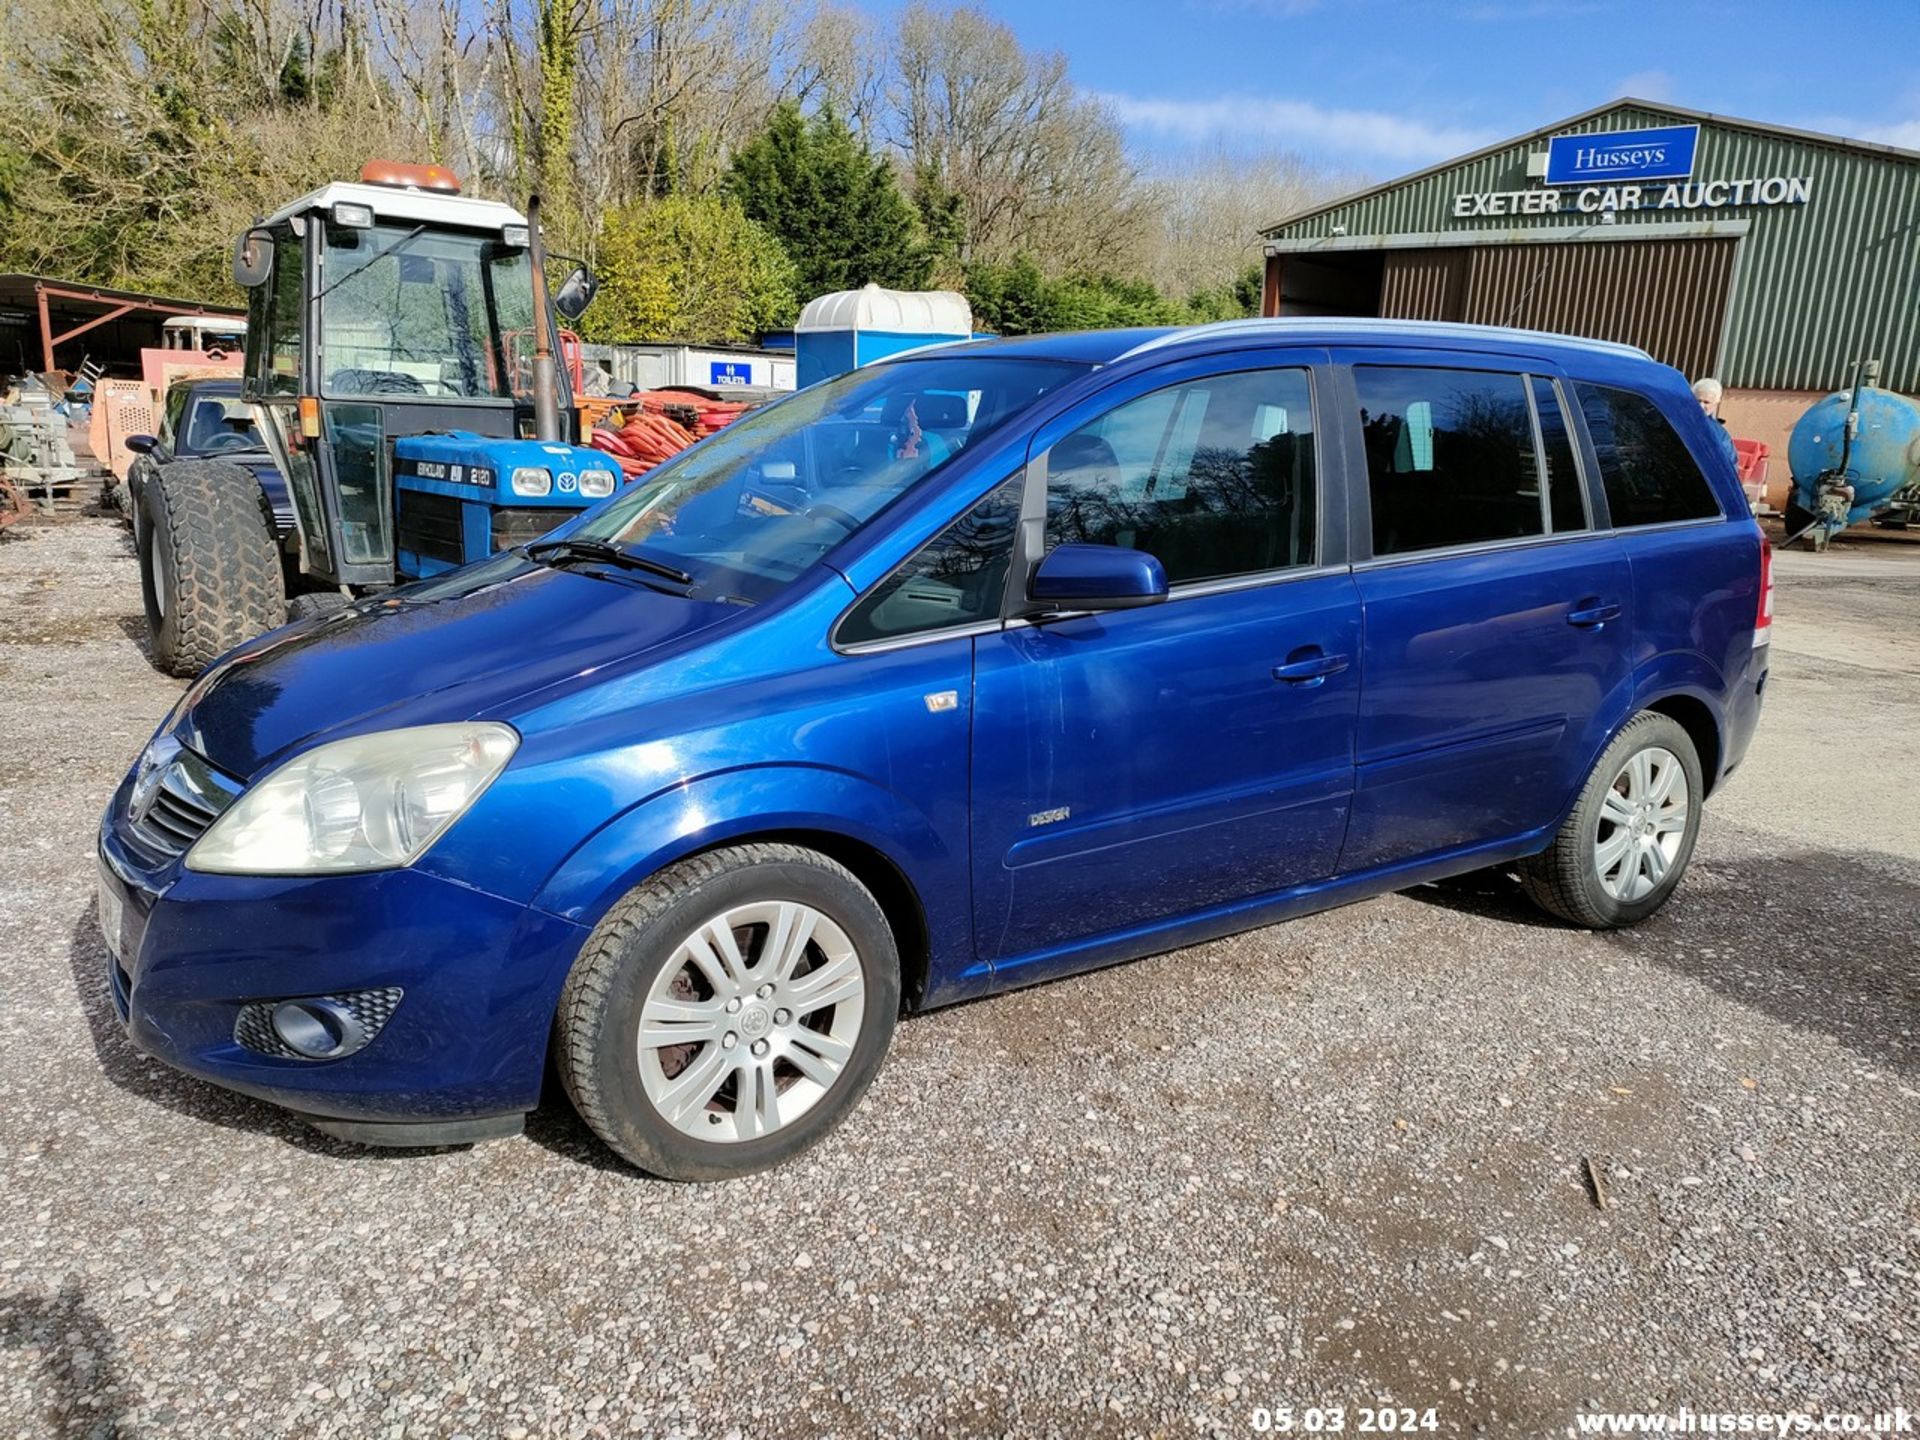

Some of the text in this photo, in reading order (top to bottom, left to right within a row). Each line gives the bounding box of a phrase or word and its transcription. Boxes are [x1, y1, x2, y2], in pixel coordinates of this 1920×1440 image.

[1574, 147, 1666, 169] Husseys
[1454, 176, 1814, 218] EXETER CAR AUCTION
[716, 374, 747, 385] TOILETS
[1030, 806, 1070, 826] DESIGN
